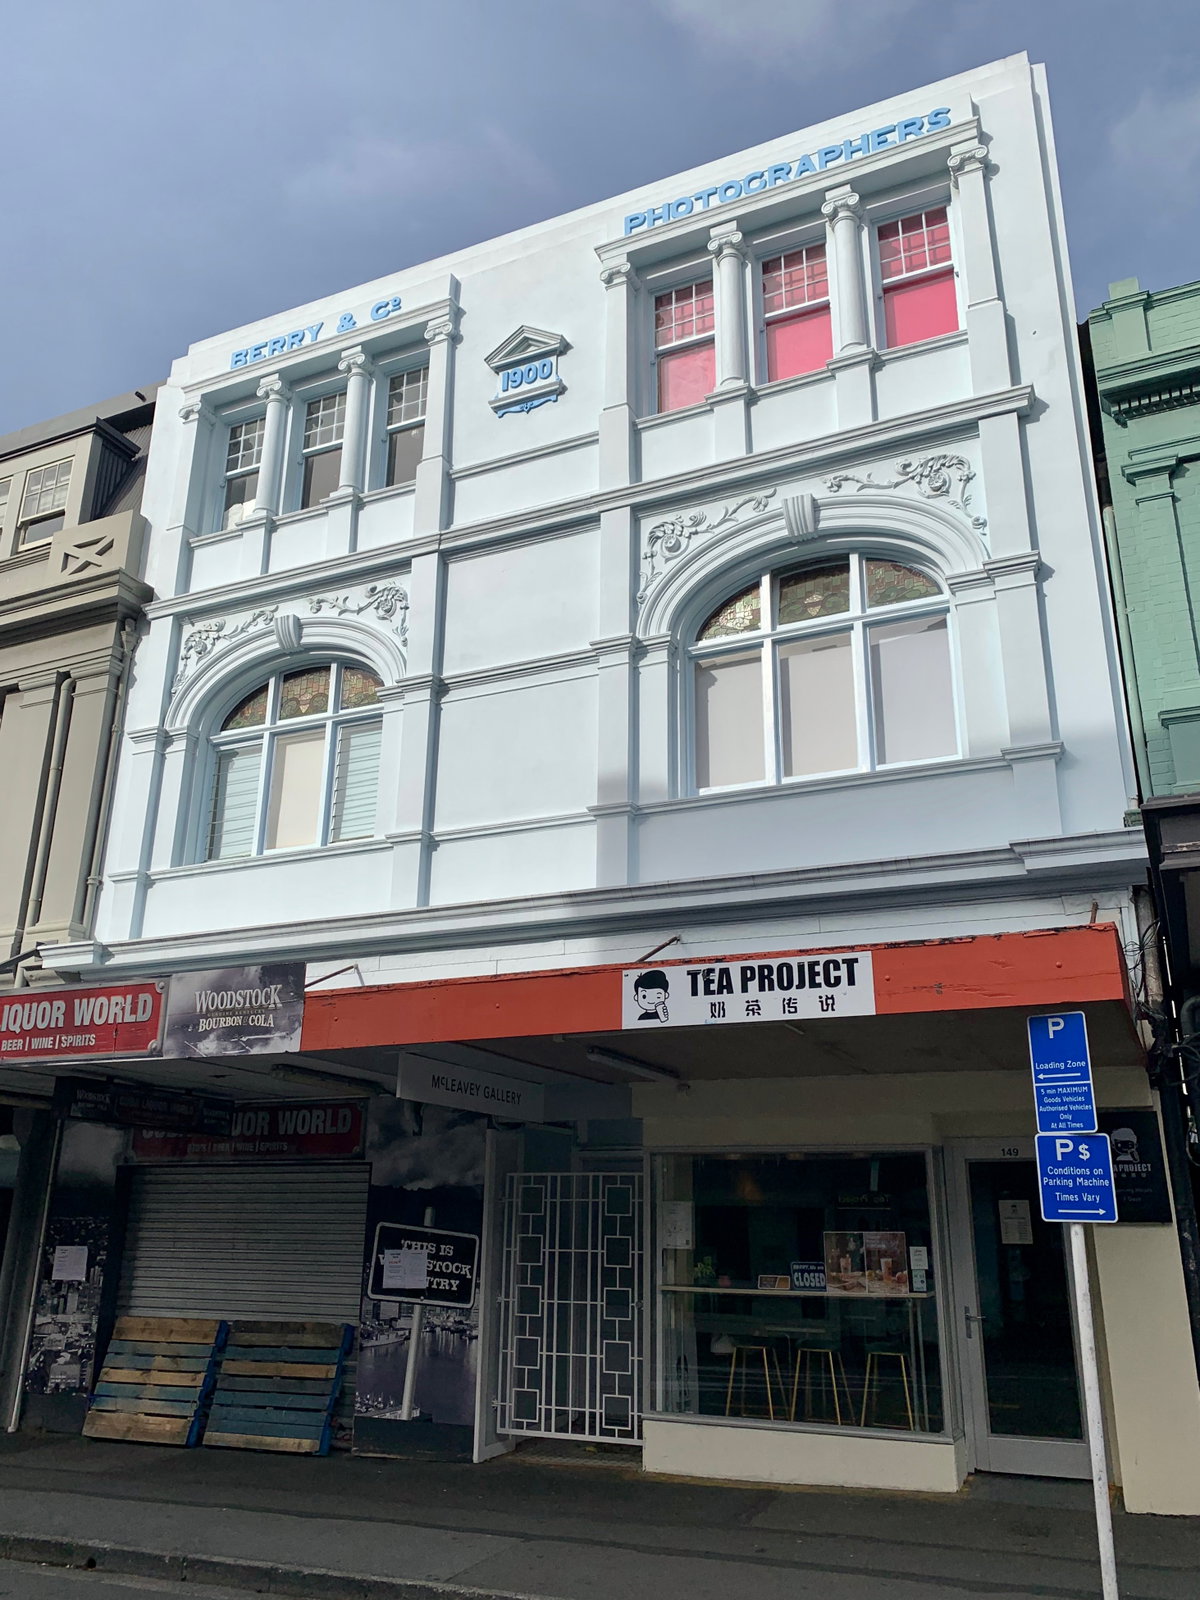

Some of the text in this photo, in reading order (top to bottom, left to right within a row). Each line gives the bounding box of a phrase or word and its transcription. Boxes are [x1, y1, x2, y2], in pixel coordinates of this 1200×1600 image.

[623, 106, 951, 236] PHOTOGRAPHERS
[230, 321, 324, 370] BERRY
[336, 312, 357, 333] &
[501, 358, 553, 392] 1900
[686, 957, 859, 997] TEA PROJECT
[195, 984, 283, 1015] WOODSTOCK
[709, 994, 836, 1019] 奶茶传说
[0, 992, 154, 1034] IQUOR WORLD
[198, 1015, 243, 1032] BOURBON
[249, 1014, 275, 1028] COLA
[1047, 1017, 1065, 1039] P
[1, 1034, 96, 1052] BEER WINE SPIRITS
[1035, 1060, 1086, 1070] Loading Zone
[483, 1086, 522, 1105] GALLERY
[1039, 1104, 1068, 1112] Authorised
[277, 1107, 352, 1136] WORLD
[1001, 1147, 1019, 1157] 149
[1055, 1138, 1091, 1161] P $
[1047, 1165, 1090, 1175] Conditions
[1118, 1163, 1152, 1173] PROJECT
[1043, 1177, 1110, 1188] Parking Machine
[1055, 1192, 1100, 1203] Times Vary
[401, 1239, 454, 1257] THIS IS
[793, 1272, 826, 1288] CLOSED
